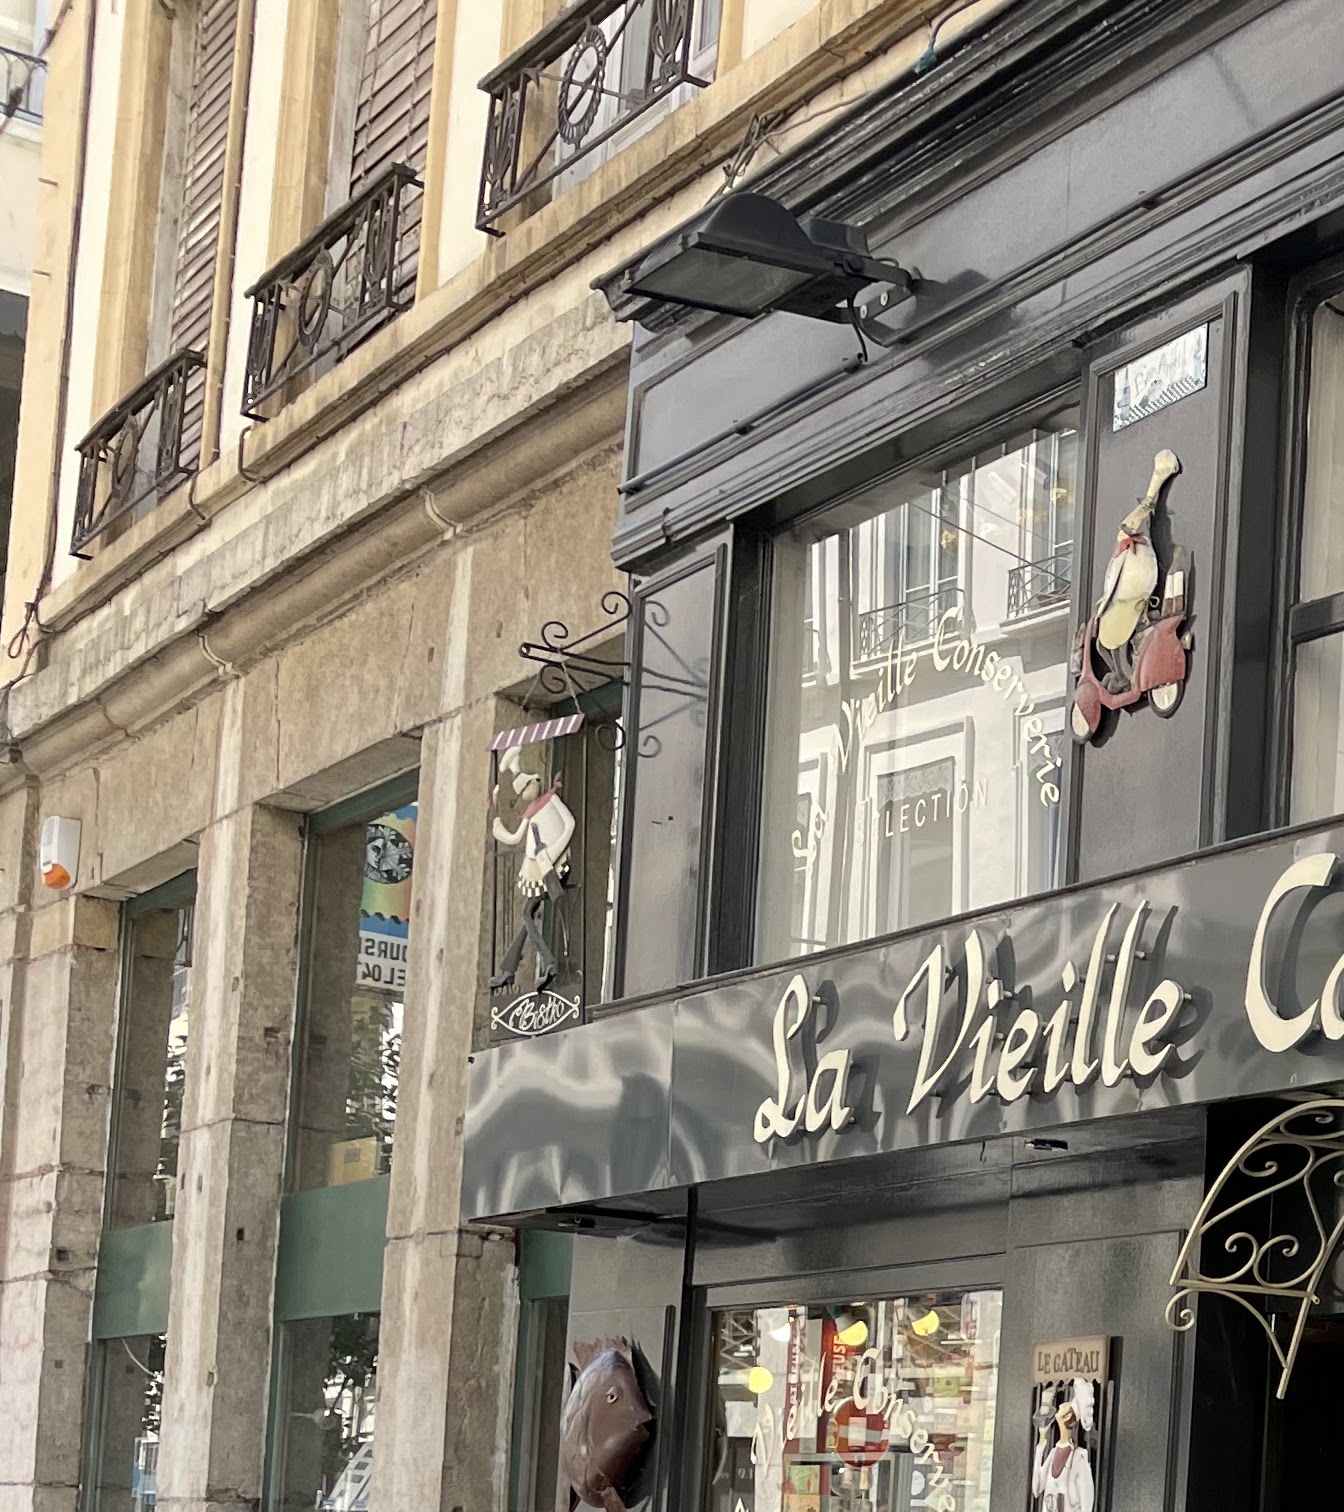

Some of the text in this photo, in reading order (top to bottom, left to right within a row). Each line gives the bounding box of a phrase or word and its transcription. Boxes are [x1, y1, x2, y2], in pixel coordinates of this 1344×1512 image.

[755, 973, 852, 1144] La
[893, 901, 1183, 1110] Vieille
[1037, 1347, 1100, 1375] LE GATEAU
